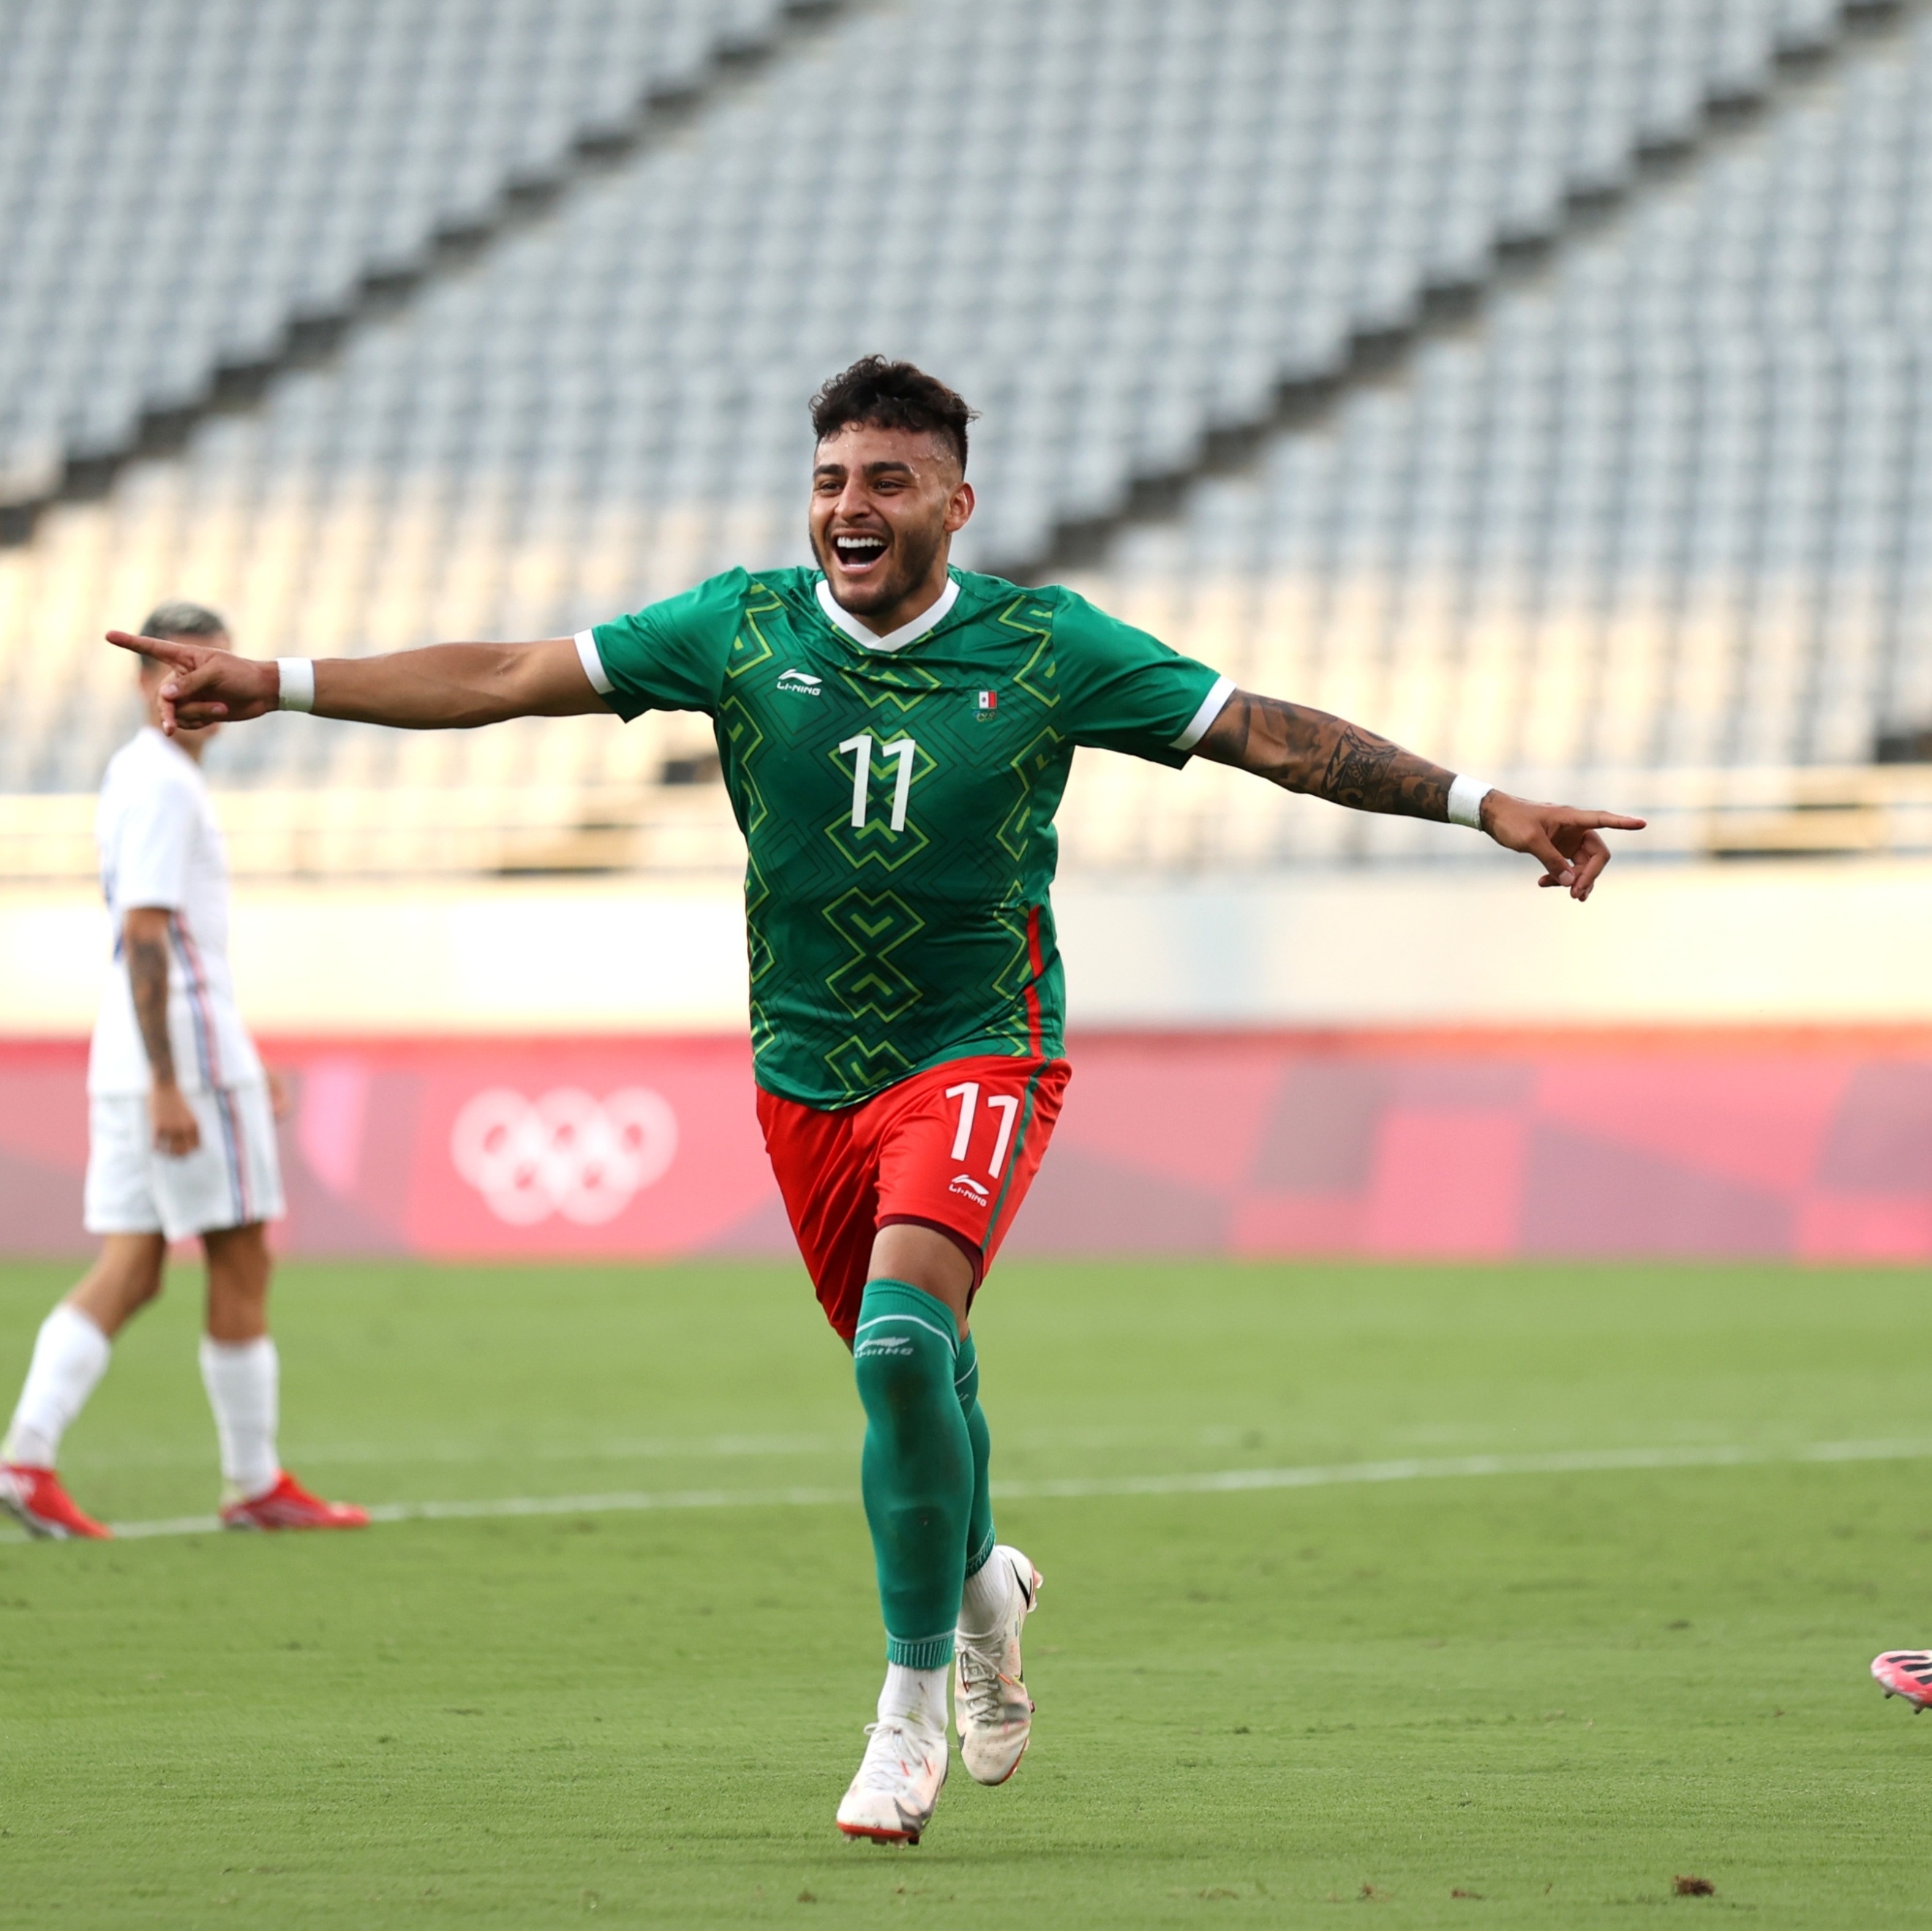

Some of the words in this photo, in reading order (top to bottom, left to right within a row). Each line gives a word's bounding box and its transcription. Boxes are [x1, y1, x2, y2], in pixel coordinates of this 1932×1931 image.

[776, 682, 822, 696] LI-NING
[839, 734, 916, 832] 11
[945, 1081, 1019, 1179] 11
[948, 1183, 988, 1208] LI-NING
